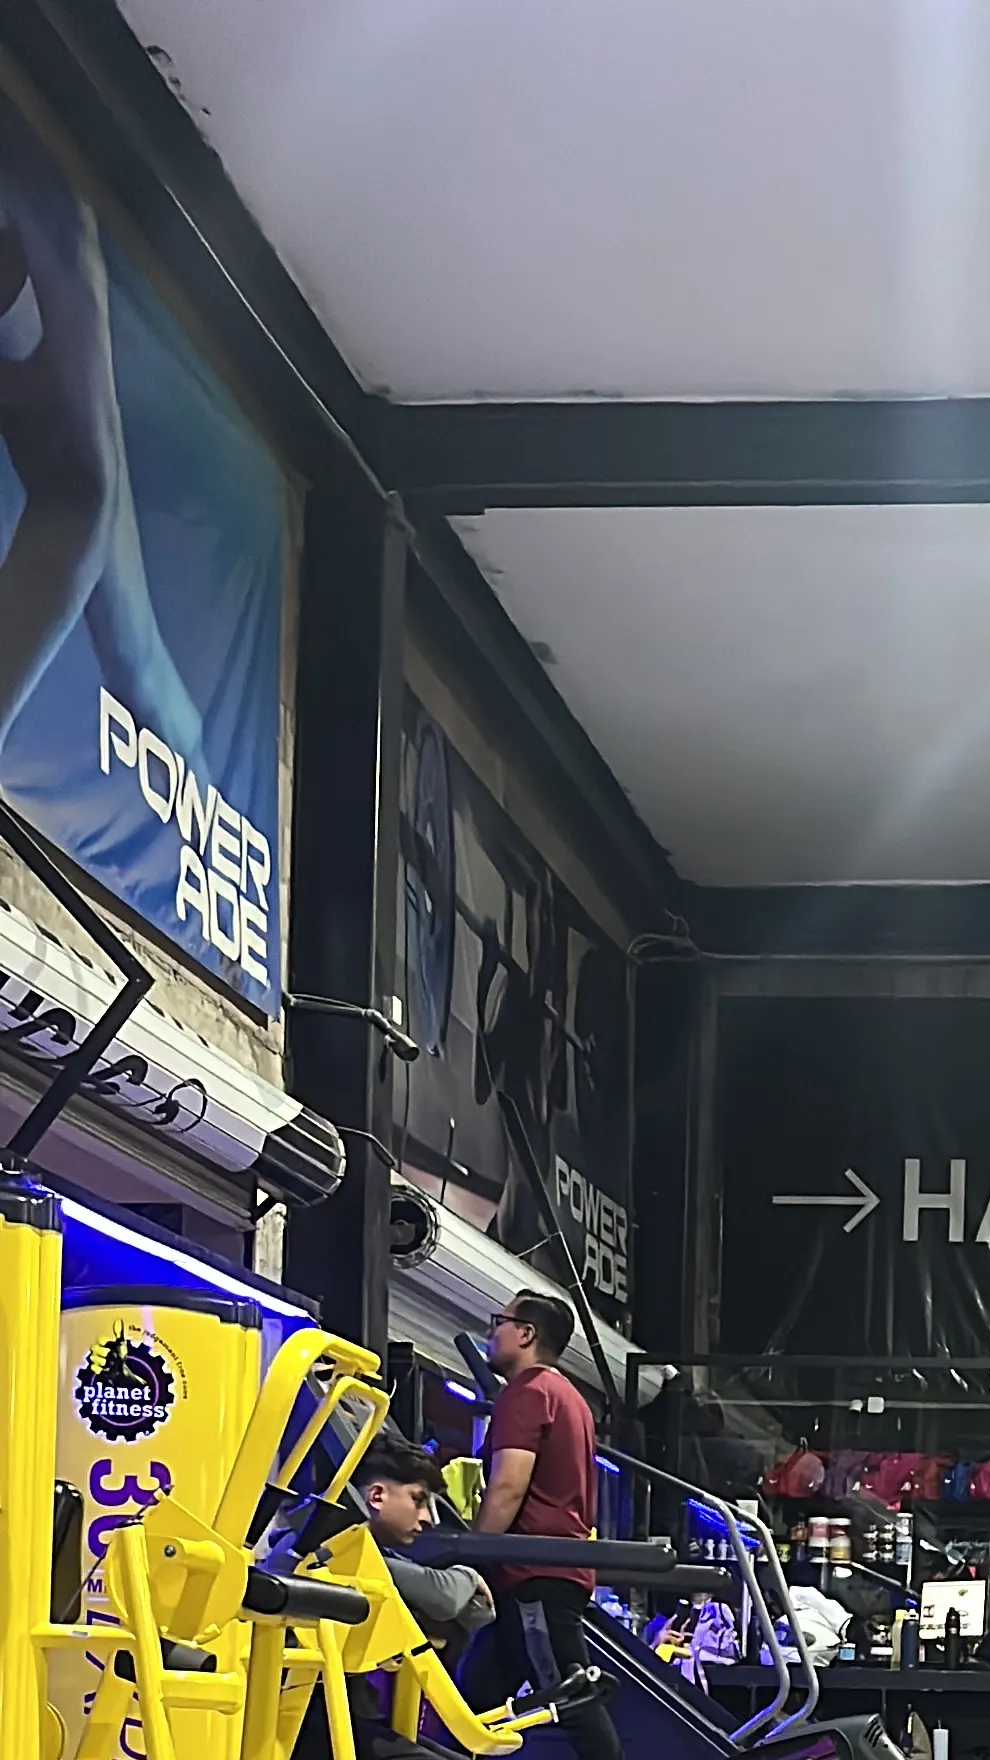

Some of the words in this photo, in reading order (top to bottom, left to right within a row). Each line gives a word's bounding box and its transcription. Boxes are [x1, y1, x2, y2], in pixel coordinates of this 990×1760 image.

[100, 686, 271, 911] POWER
[177, 845, 271, 989] ADE
[555, 1154, 628, 1254] POWER
[582, 1234, 628, 1304] ADE
[83, 1382, 151, 1403] planet
[91, 1398, 165, 1418] fitness
